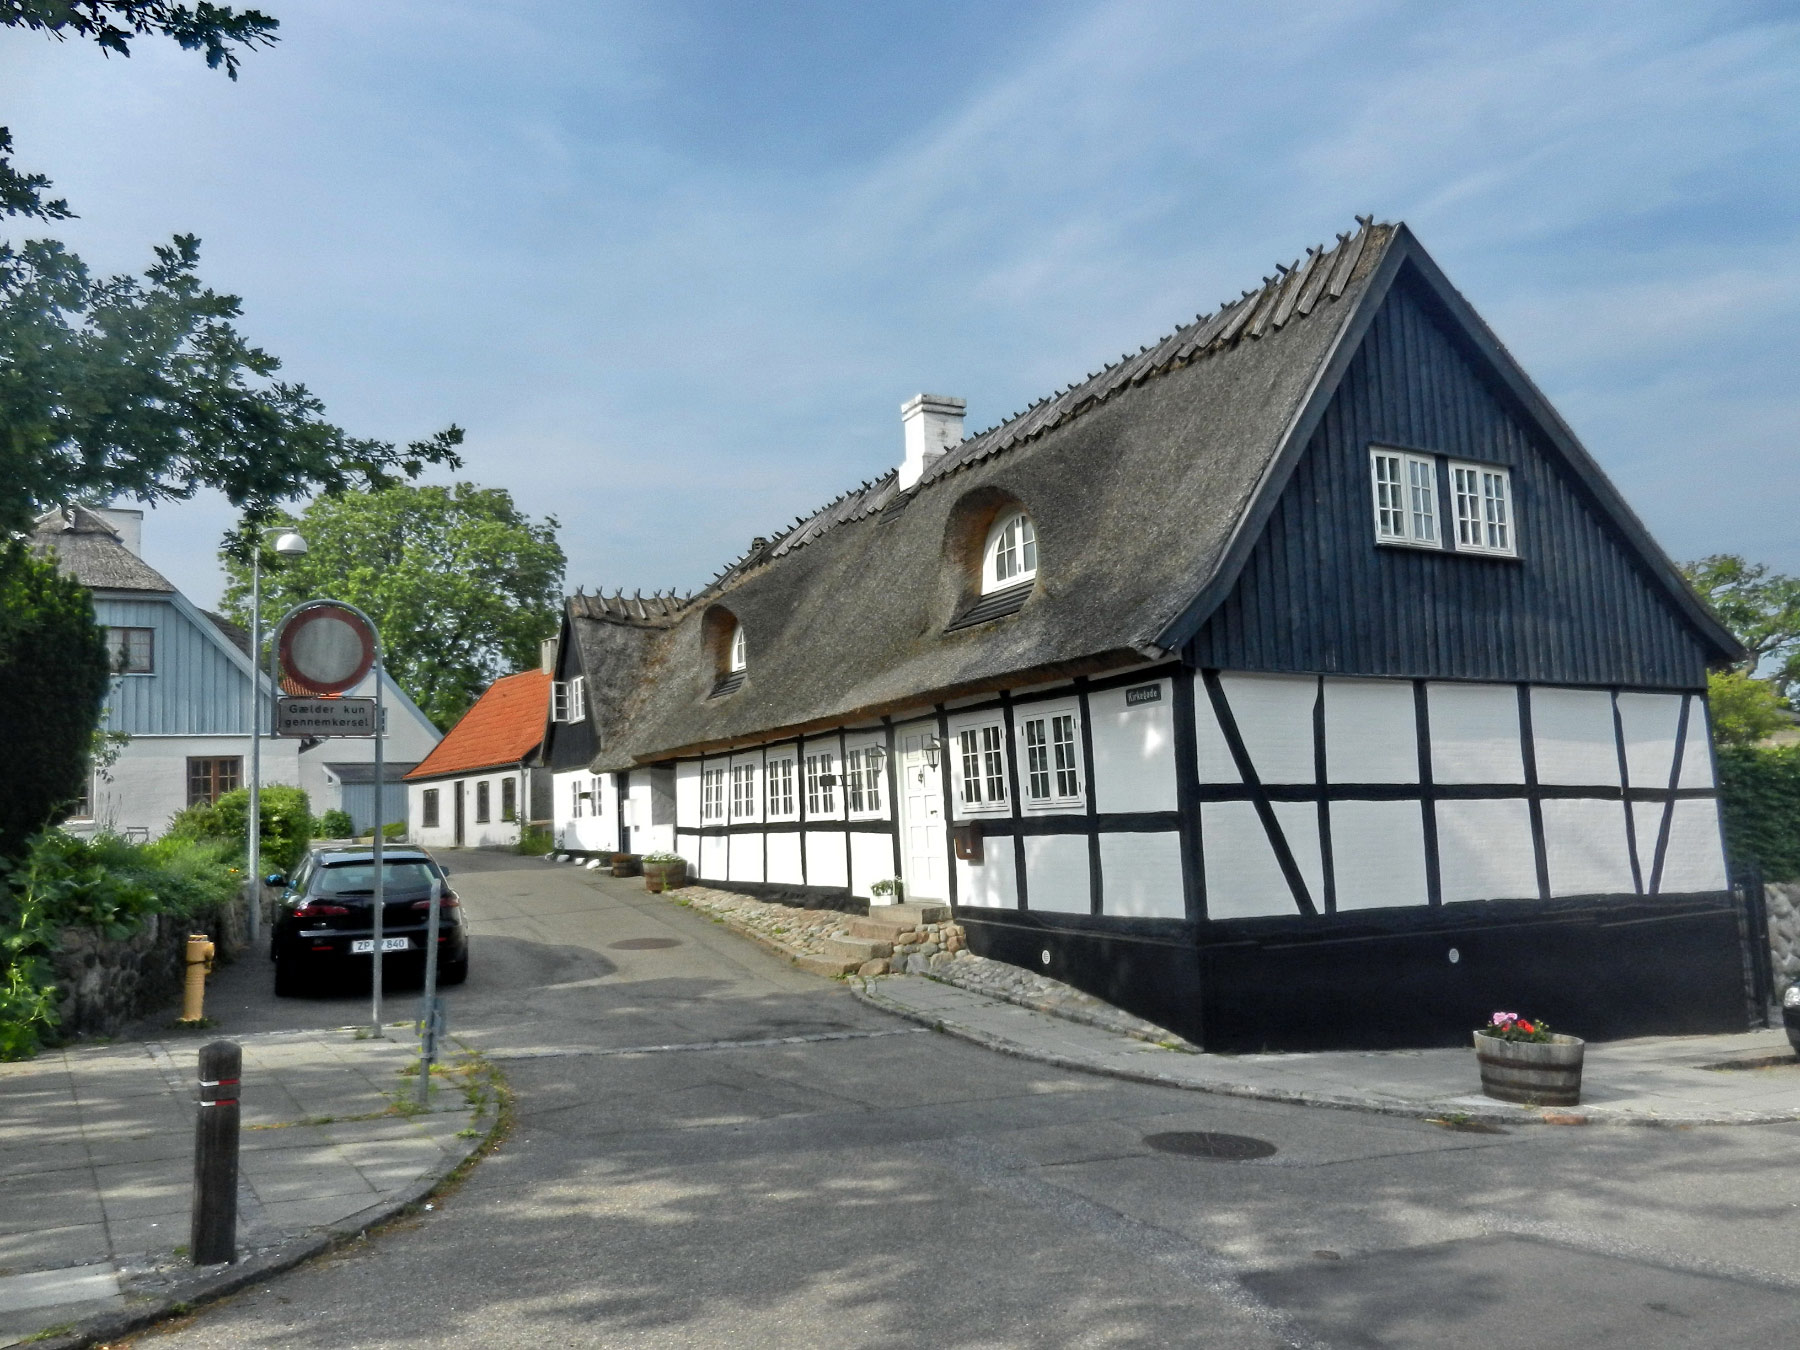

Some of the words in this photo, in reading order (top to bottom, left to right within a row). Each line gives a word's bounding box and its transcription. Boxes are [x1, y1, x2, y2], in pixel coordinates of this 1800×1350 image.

[289, 704, 335, 714] Gælder
[343, 705, 365, 714] kun
[285, 718, 369, 728] gennemkørsel
